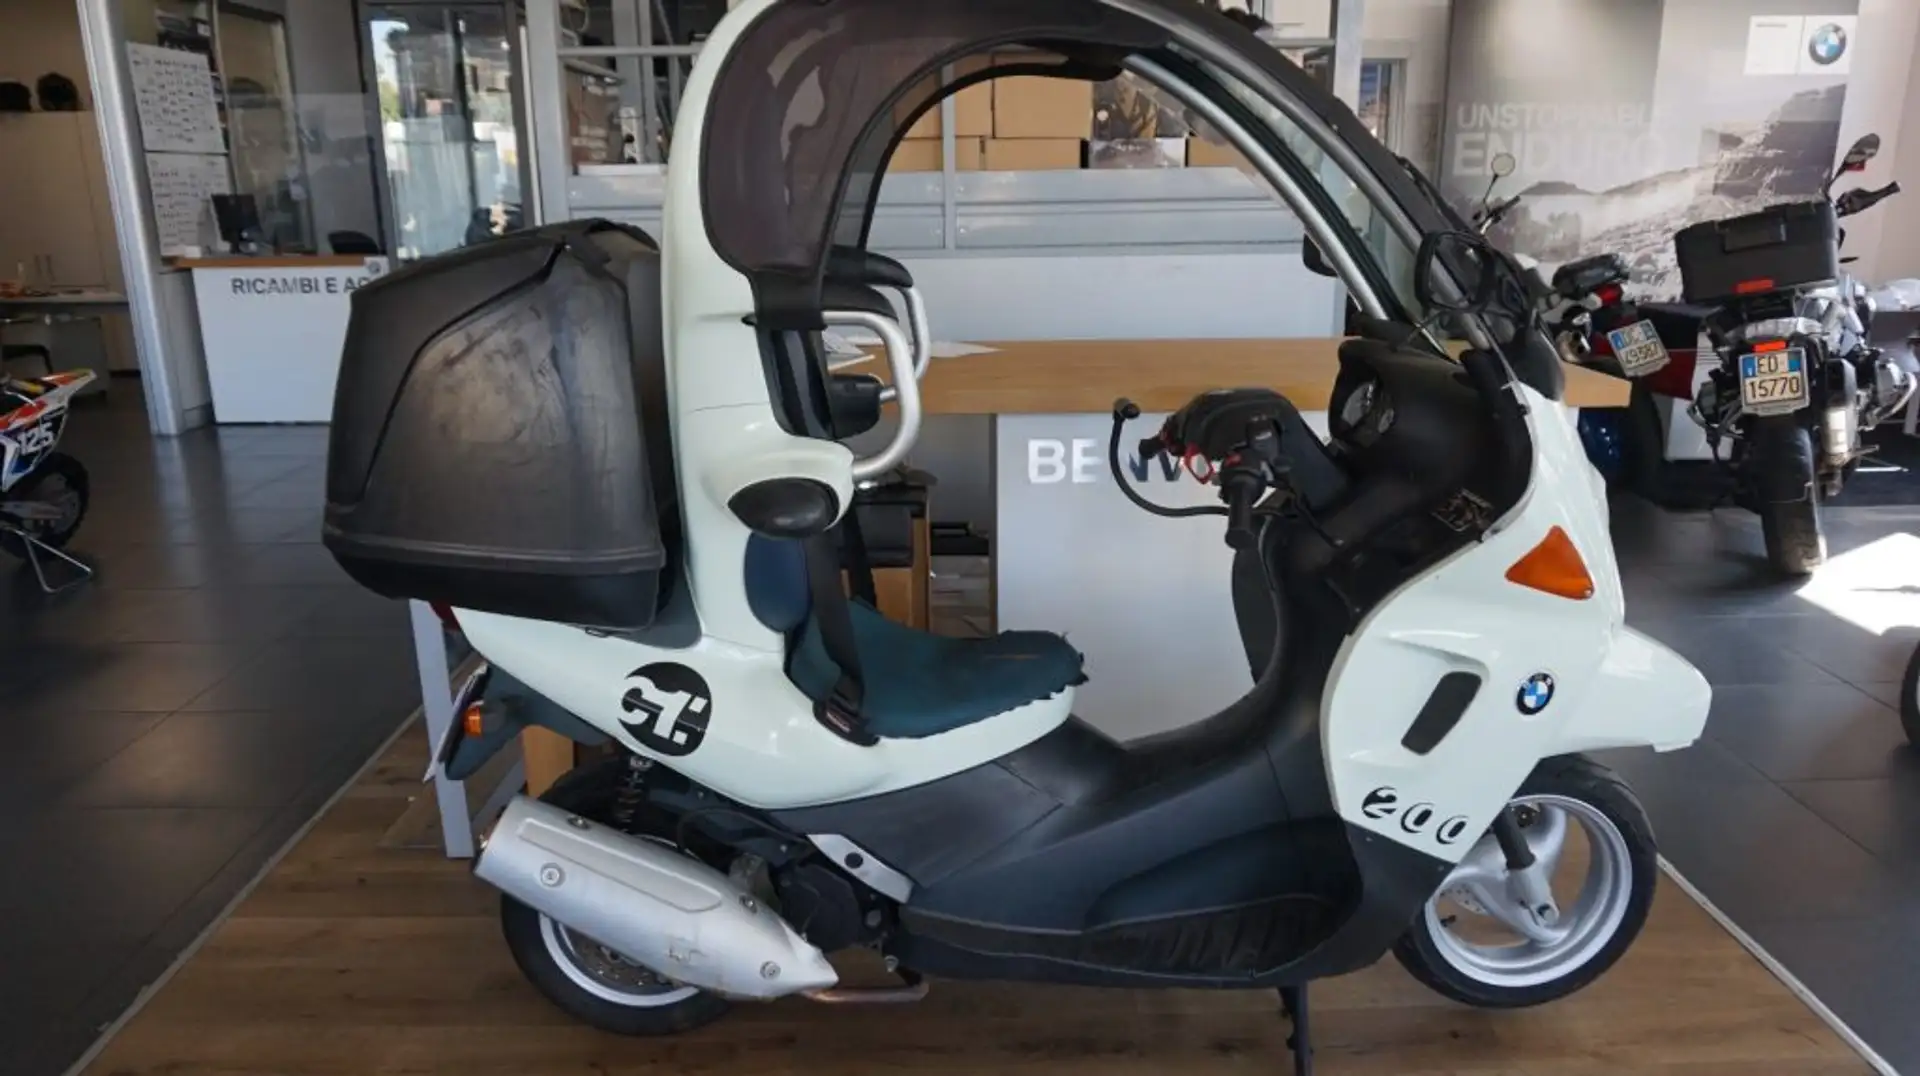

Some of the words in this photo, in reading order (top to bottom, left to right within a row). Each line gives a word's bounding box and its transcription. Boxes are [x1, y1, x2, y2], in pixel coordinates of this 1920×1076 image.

[1453, 131, 1667, 176] ENDURO
[231, 276, 320, 295] RICAMBI
[325, 276, 338, 294] E
[1749, 376, 1800, 399] 15770
[17, 422, 54, 456] 125
[1027, 438, 1218, 484] BENV
[1361, 786, 1470, 845] 200
